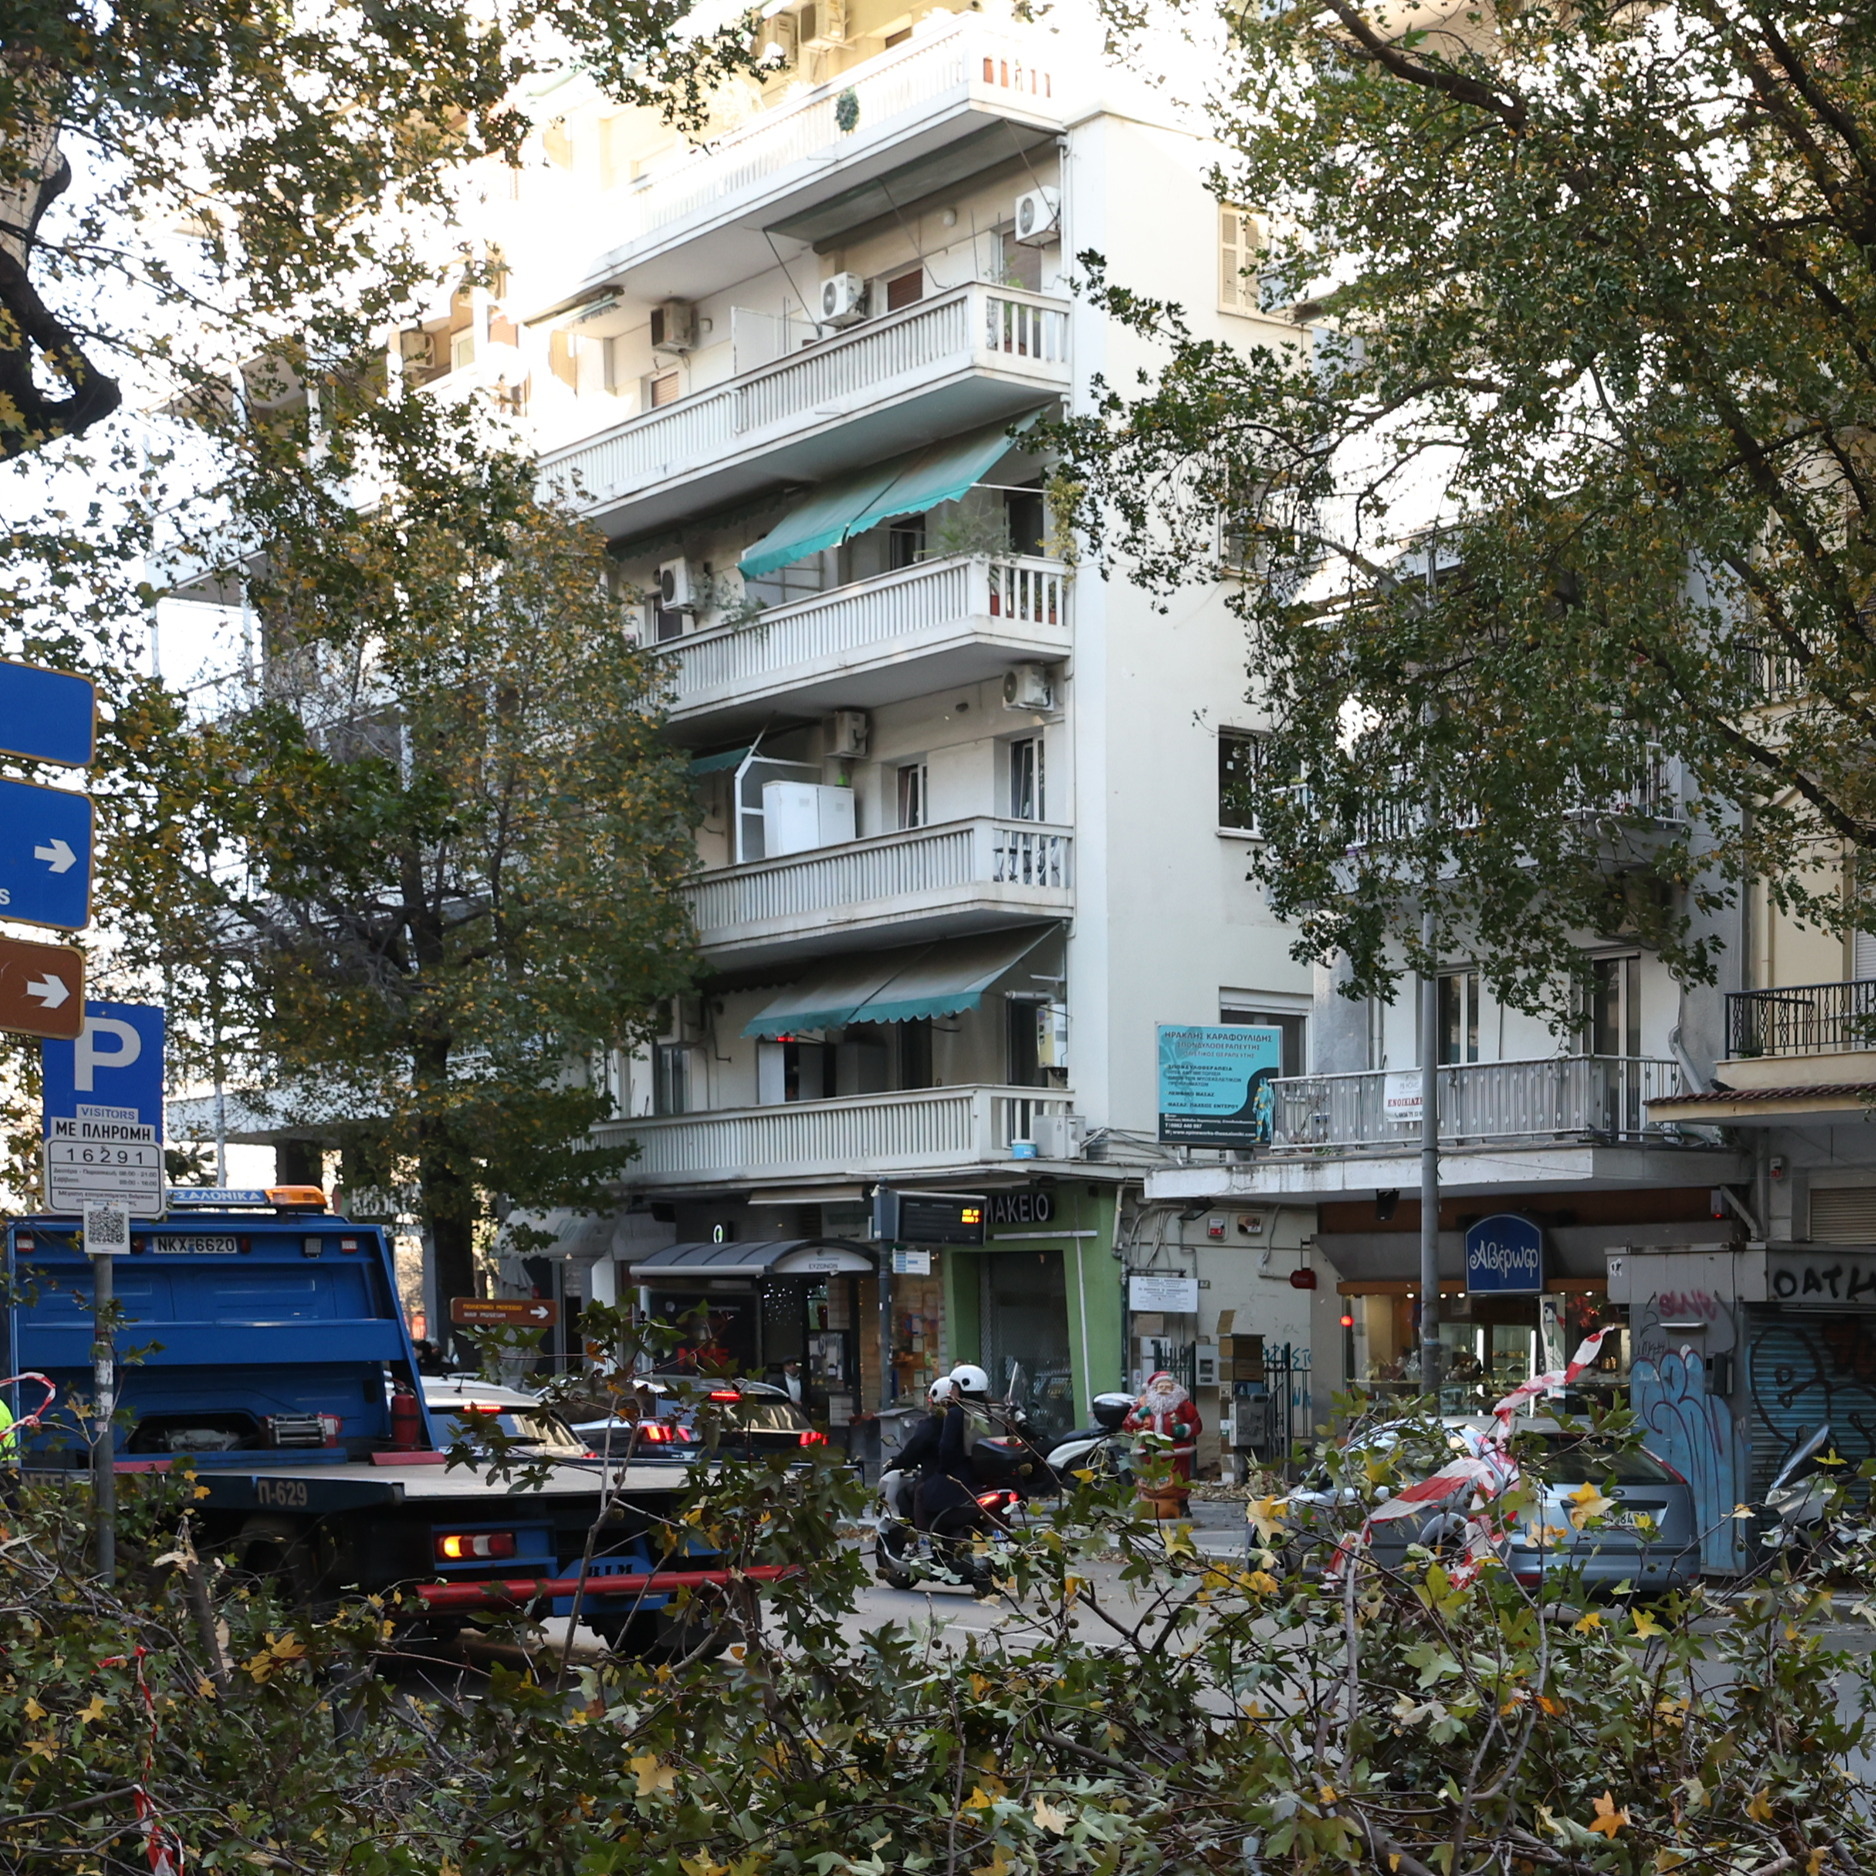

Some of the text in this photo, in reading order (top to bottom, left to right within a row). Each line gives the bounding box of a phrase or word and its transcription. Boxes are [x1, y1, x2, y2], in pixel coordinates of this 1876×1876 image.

[1164, 1031, 1273, 1043] ΗΡΑΚΛΗΣ ΚΑΡΑΦΟΥΛΙΔΗΣ
[74, 1016, 141, 1092] P
[81, 1107, 135, 1120] VISITORS
[56, 1121, 150, 1141] ΜΕ ΠΛΗΡΩΜΗ
[66, 1148, 142, 1164] 16291
[172, 1190, 261, 1201] ΣΑΛΟΝΙΚΑ
